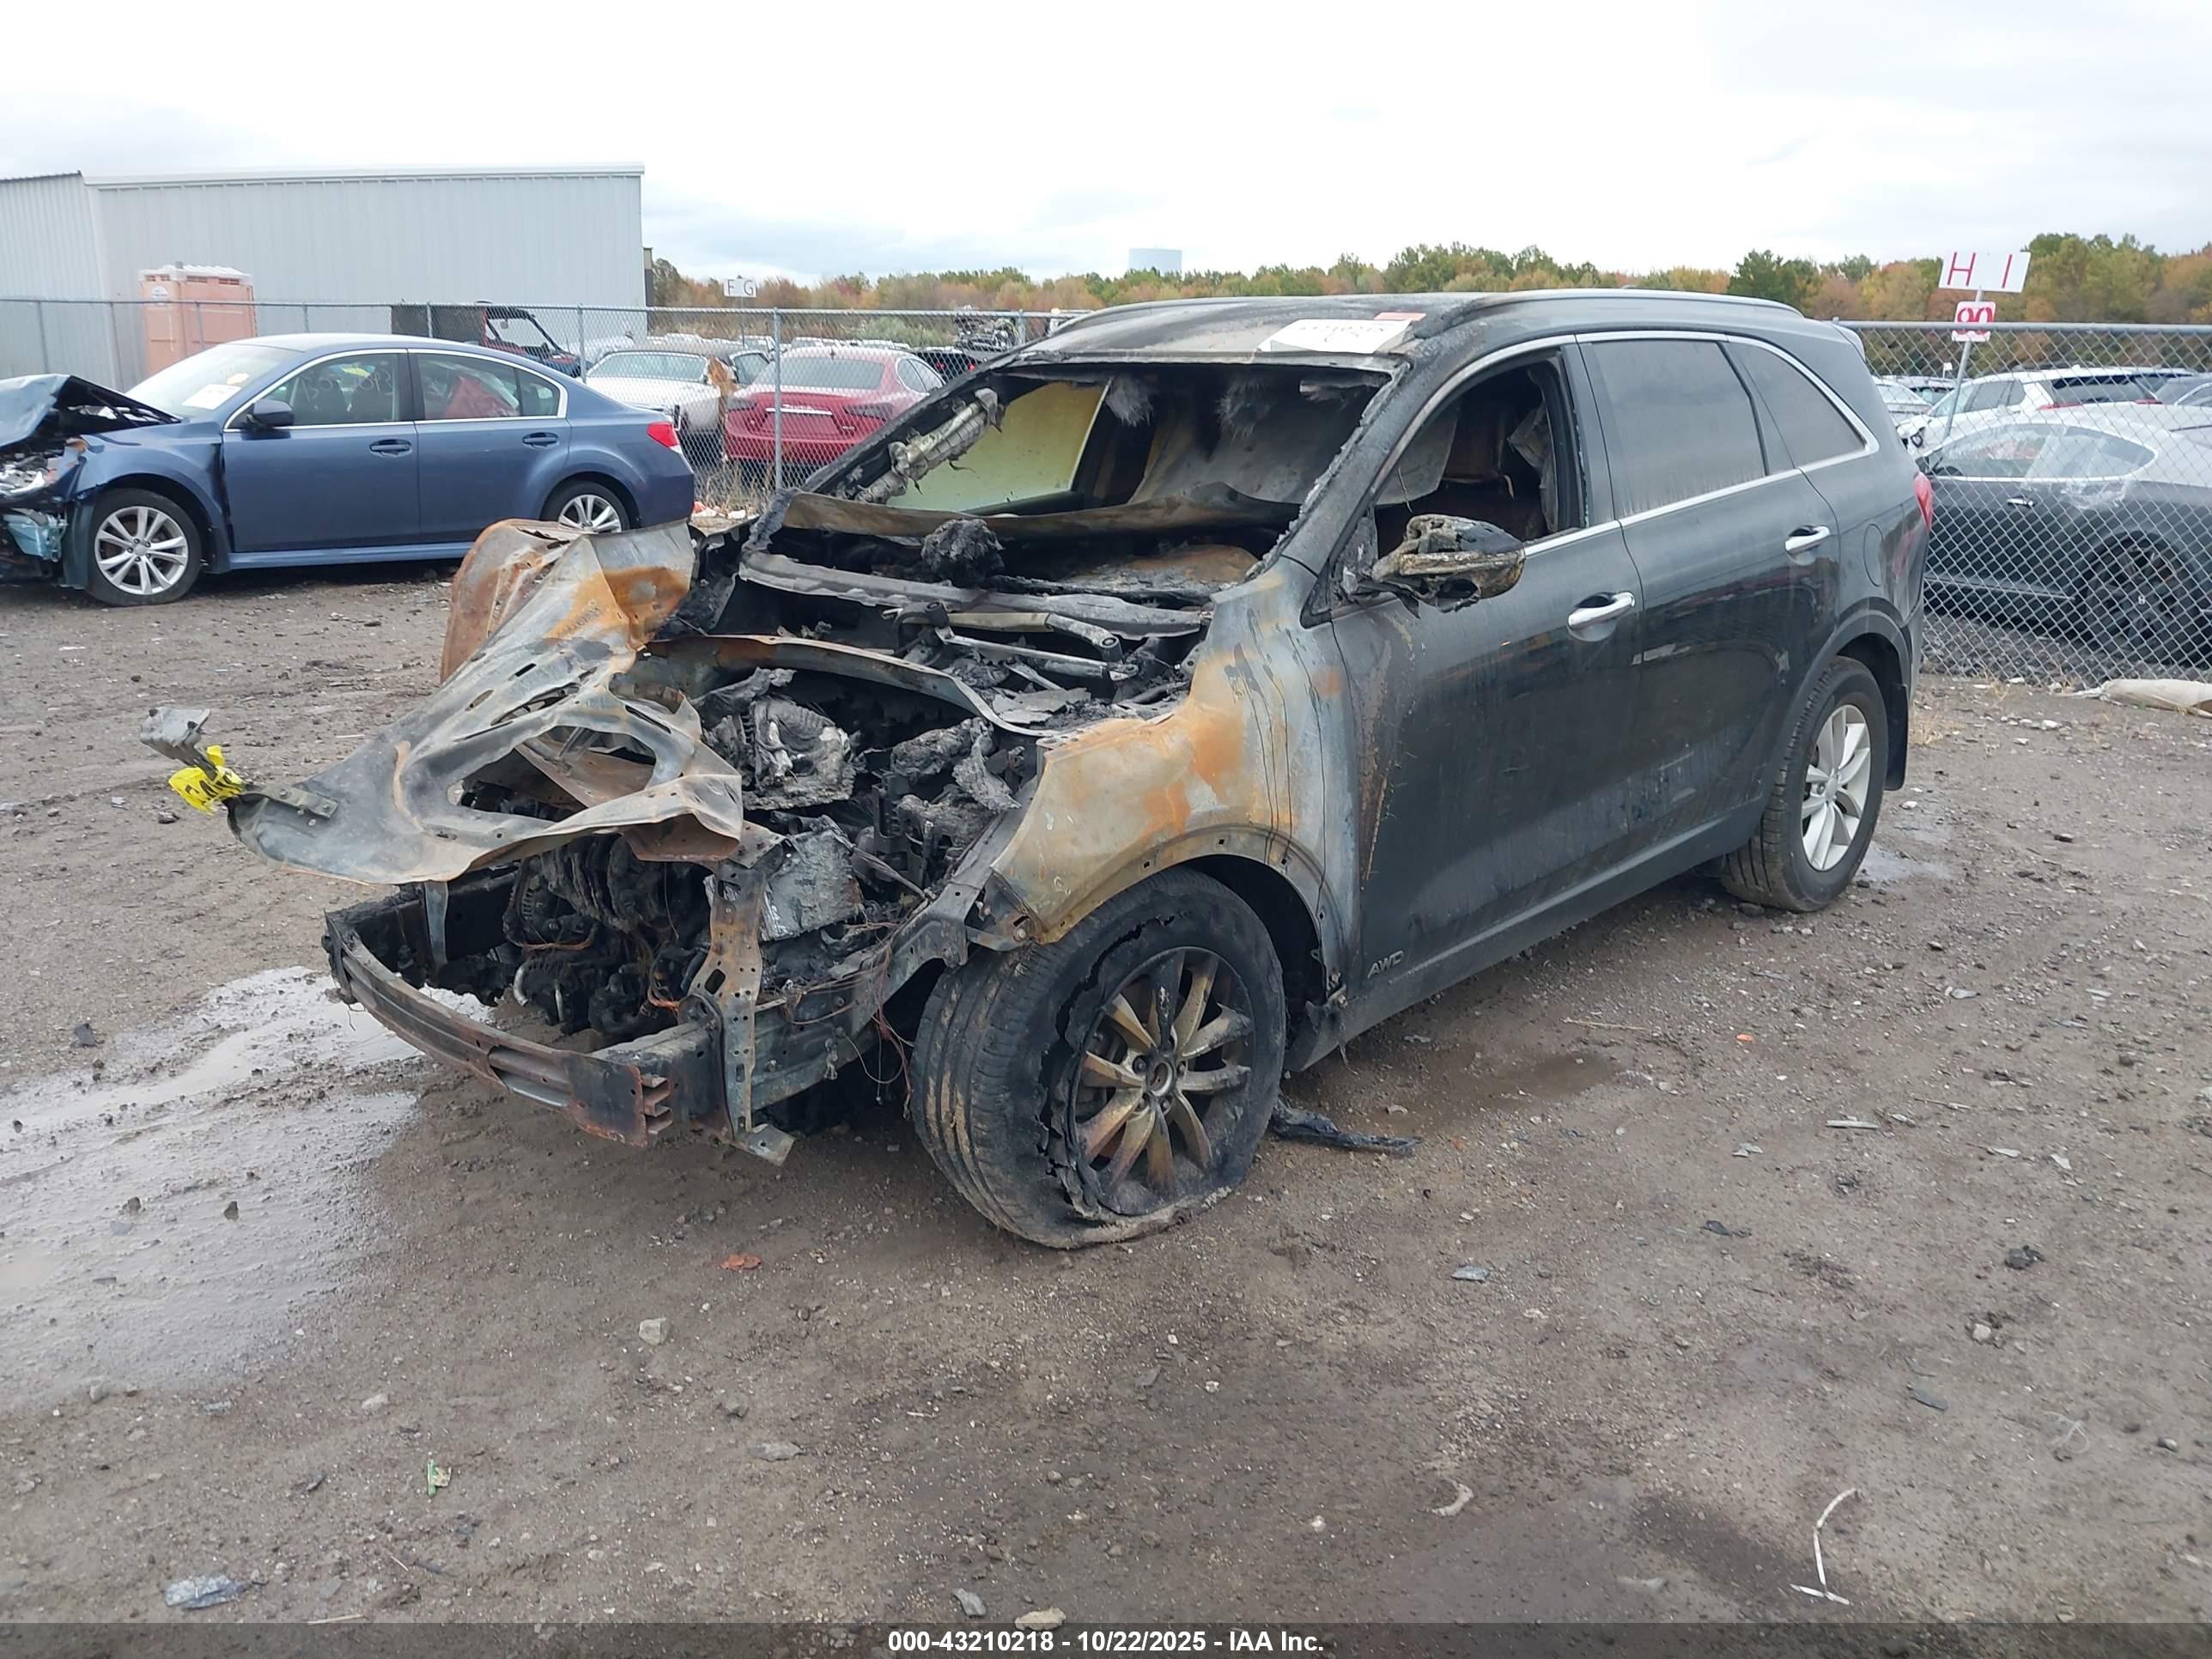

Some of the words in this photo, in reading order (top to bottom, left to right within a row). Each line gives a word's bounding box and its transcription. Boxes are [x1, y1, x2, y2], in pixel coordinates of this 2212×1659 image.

[1946, 252, 1977, 287] H
[727, 278, 735, 296] F
[743, 279, 754, 296] G
